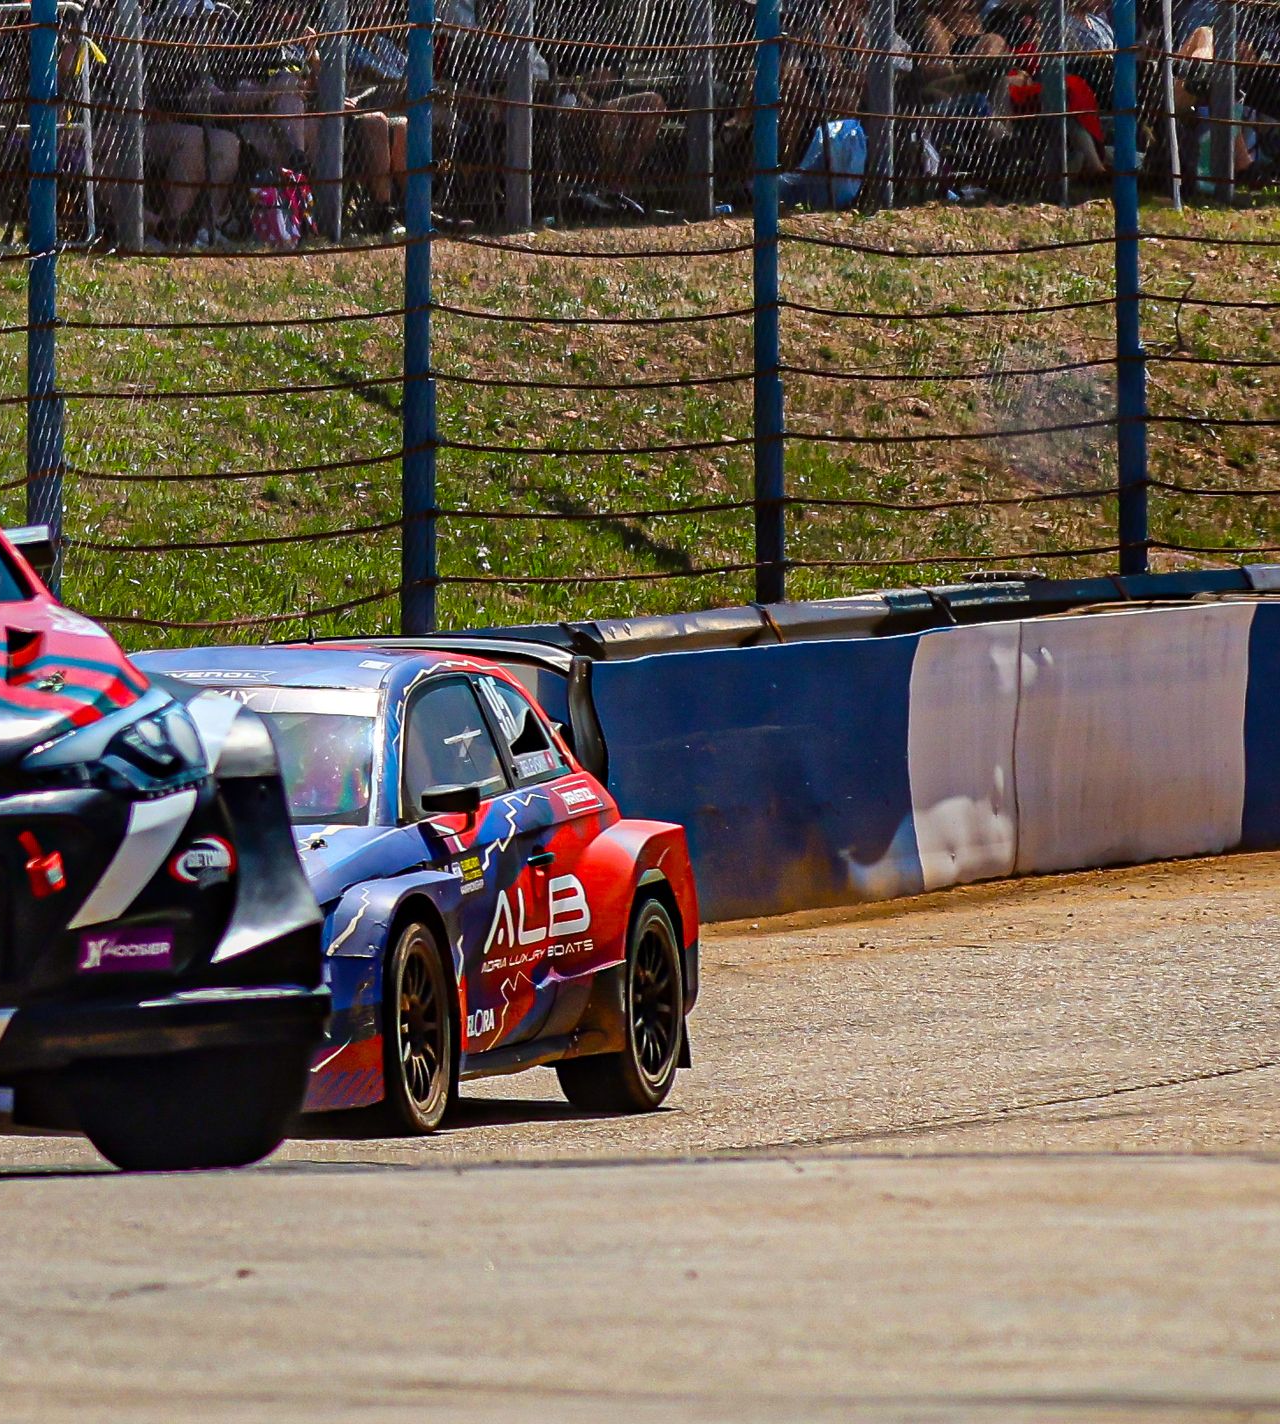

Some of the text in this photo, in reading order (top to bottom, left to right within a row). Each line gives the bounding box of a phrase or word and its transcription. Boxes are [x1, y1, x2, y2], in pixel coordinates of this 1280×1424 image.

[166, 671, 257, 679] VENOL
[478, 676, 520, 741] 95
[483, 874, 591, 955] ALB
[547, 939, 594, 956] BOATS
